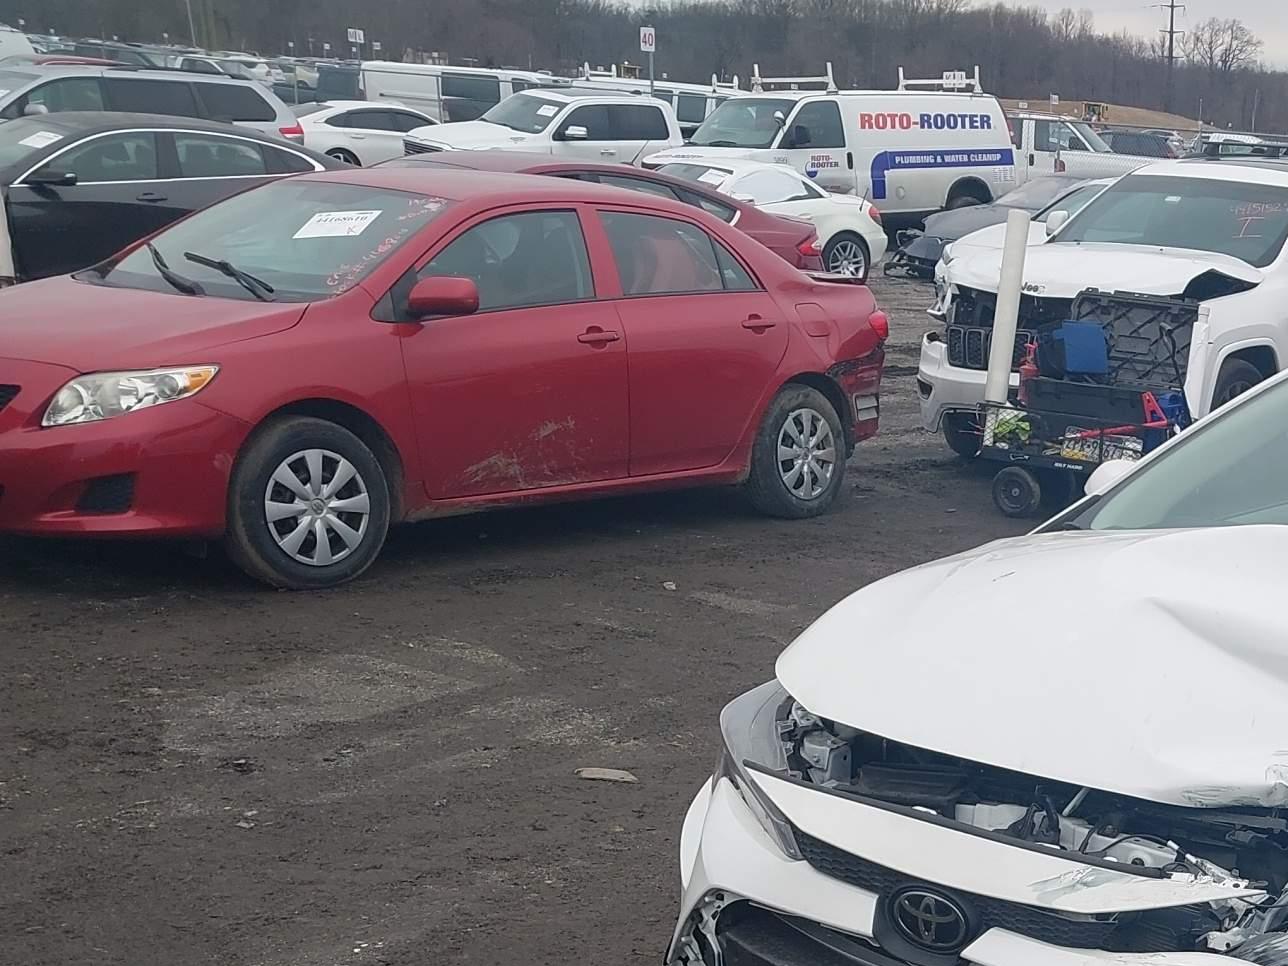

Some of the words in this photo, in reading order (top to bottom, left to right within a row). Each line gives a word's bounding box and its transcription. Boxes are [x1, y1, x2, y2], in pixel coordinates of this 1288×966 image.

[641, 32, 654, 46] 40
[859, 113, 992, 130] ROTO-ROOTER
[895, 155, 935, 164] PLUMBING
[936, 155, 943, 163] &
[944, 154, 969, 163] WATER
[970, 153, 1002, 162] CLEANUP
[810, 161, 839, 169] ROOTER
